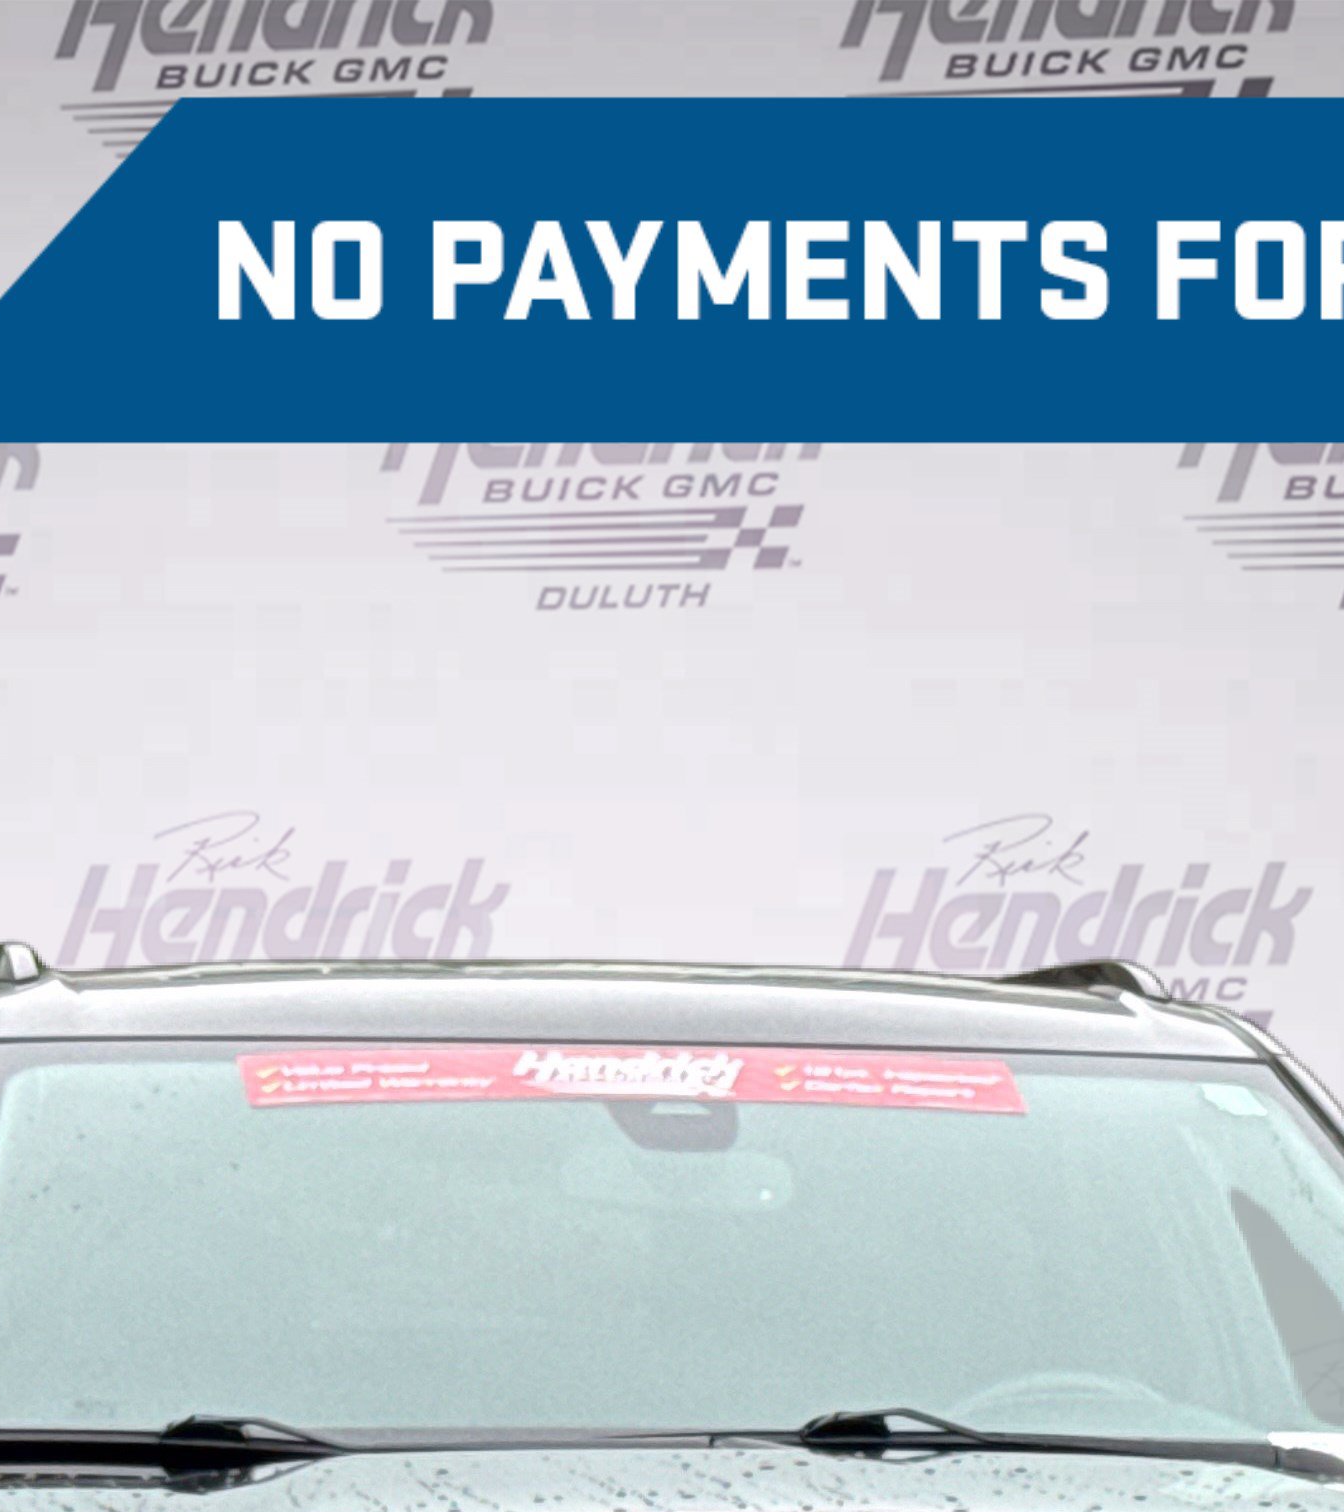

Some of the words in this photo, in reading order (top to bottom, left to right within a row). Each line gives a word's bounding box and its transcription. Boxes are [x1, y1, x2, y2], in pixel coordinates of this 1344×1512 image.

[156, 60, 316, 90] BUICK
[332, 55, 449, 82] GMC
[945, 49, 1110, 79] BUICK
[1128, 44, 1249, 70] GMC
[482, 475, 644, 504] BUICK
[662, 472, 780, 499] GMC
[536, 582, 711, 611] DULUTH
[56, 858, 511, 968] Hendrick
[841, 861, 1313, 971] Hendrick
[1169, 976, 1248, 1001] MC
